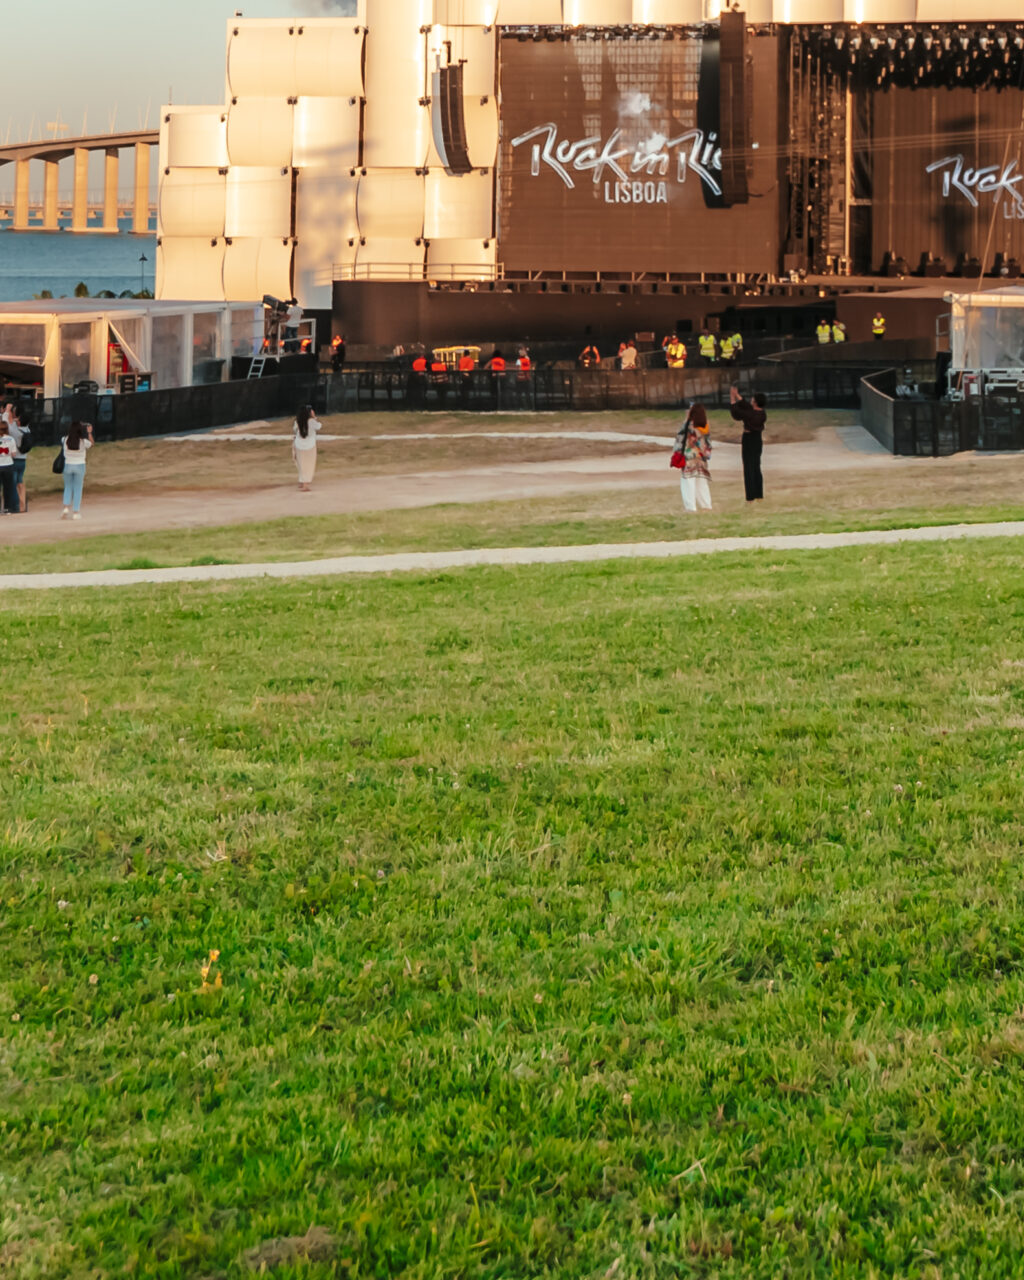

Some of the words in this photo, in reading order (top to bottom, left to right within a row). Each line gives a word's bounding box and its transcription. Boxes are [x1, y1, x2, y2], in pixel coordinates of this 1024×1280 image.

[511, 122, 629, 189] Rock
[631, 141, 670, 176] in
[666, 128, 722, 196] Ri
[926, 153, 1023, 208] Rock
[604, 180, 668, 204] LISBOA
